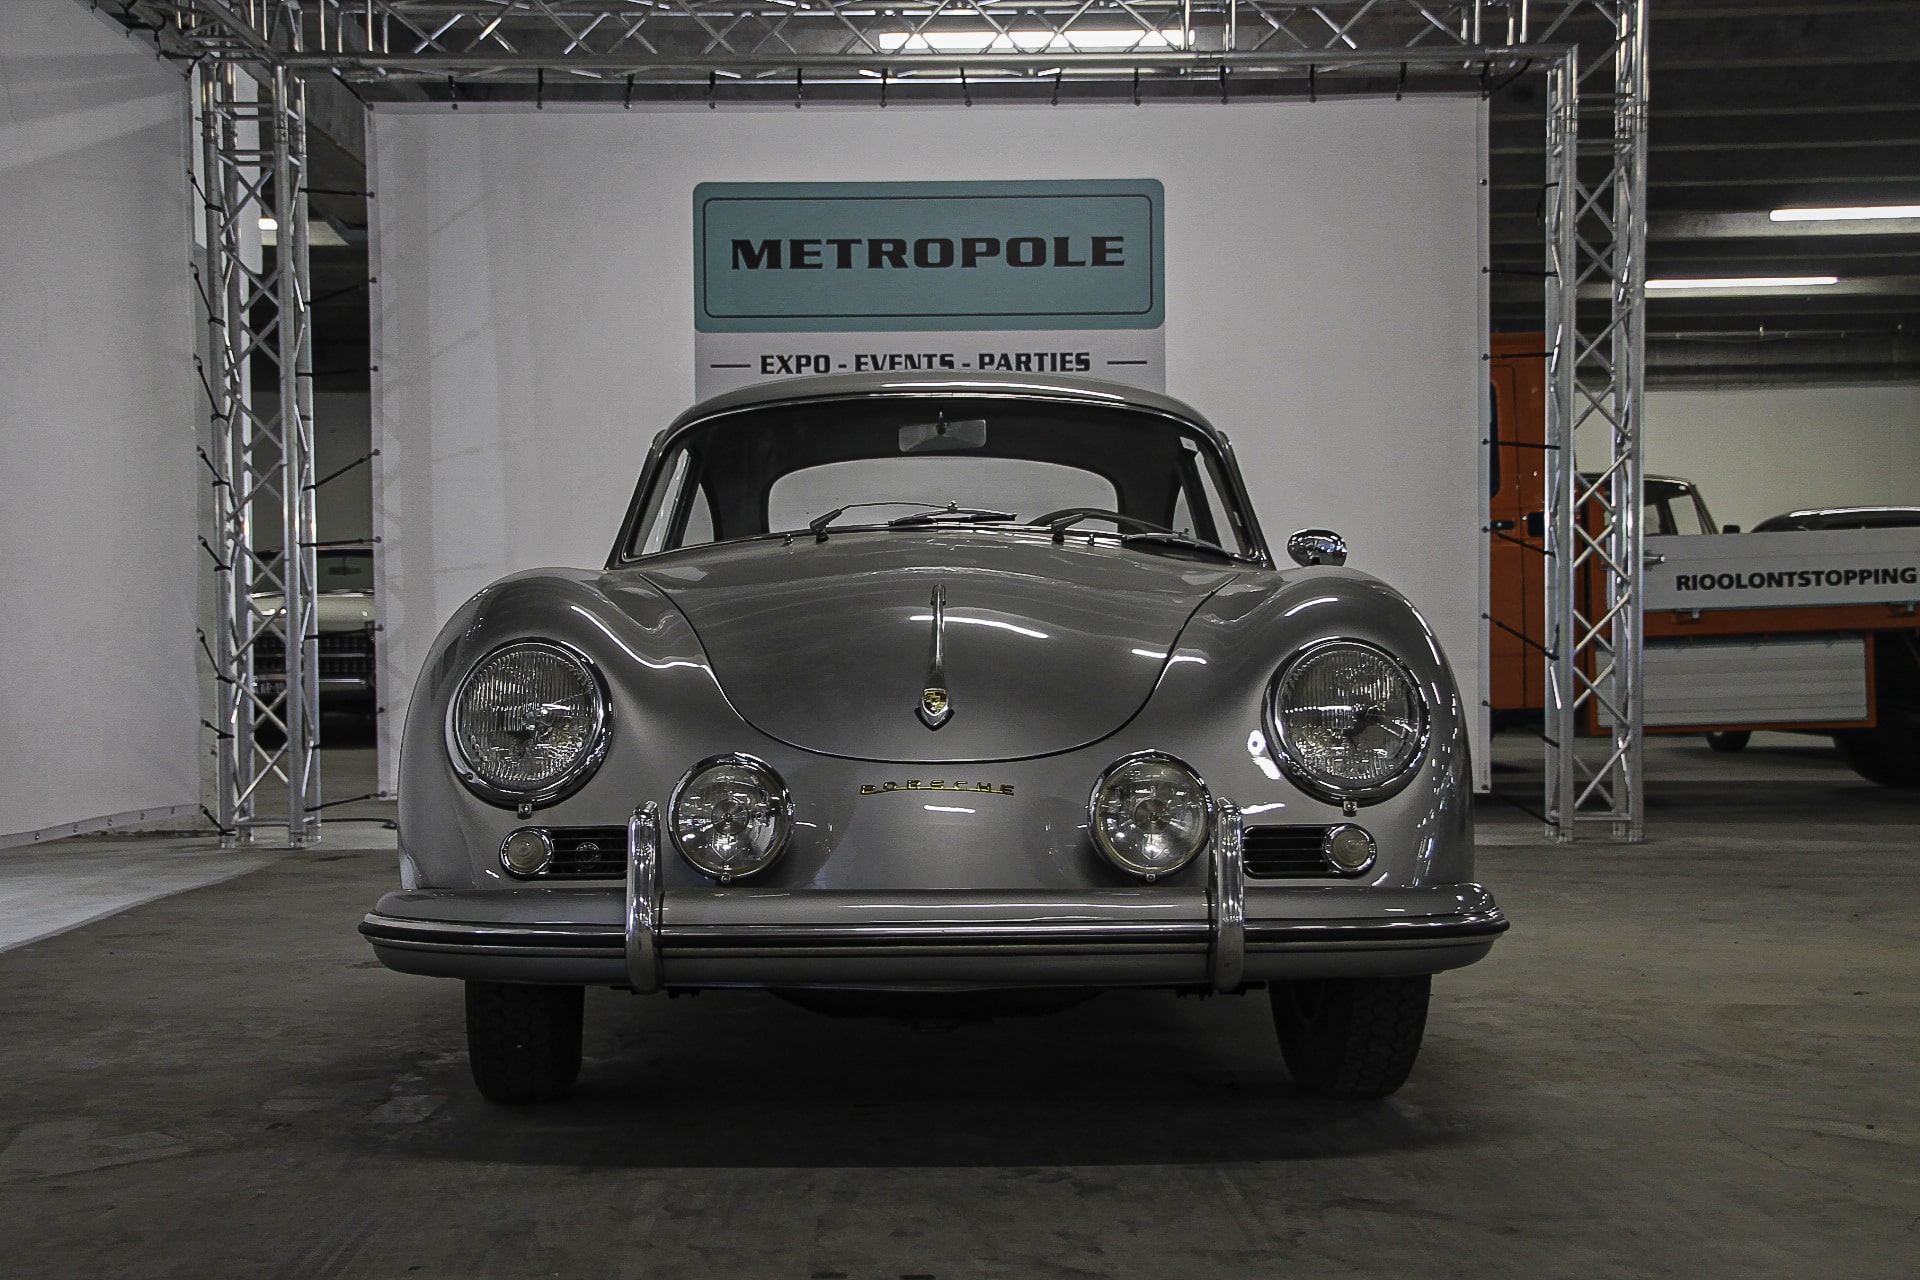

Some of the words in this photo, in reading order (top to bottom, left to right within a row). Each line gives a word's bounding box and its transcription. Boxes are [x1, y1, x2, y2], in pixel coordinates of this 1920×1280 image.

[731, 236, 1125, 270] METROPOLE
[760, 354, 831, 375] EXPO
[854, 353, 955, 372] EVENTS
[978, 352, 1091, 372] PARTIES
[1675, 566, 1918, 592] RIOOLONTSTOPPING
[860, 779, 1015, 796] PORSCHE
